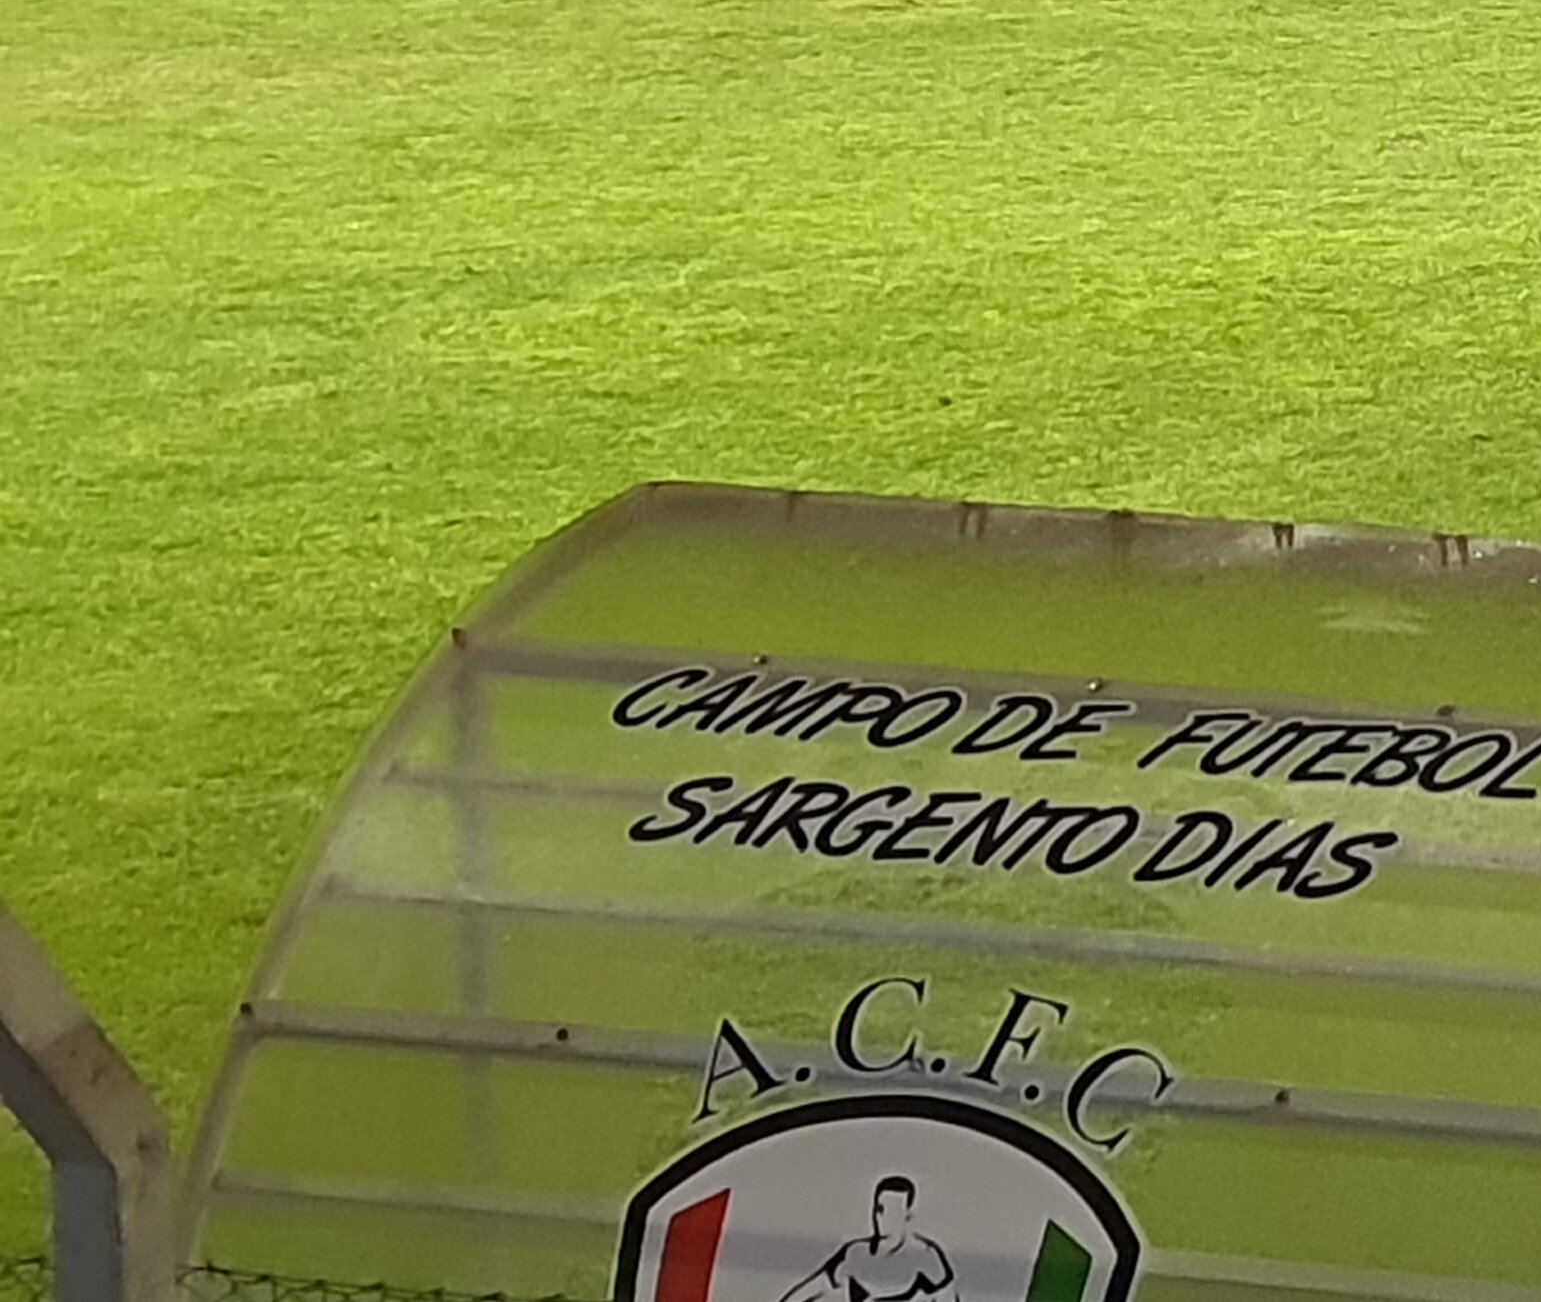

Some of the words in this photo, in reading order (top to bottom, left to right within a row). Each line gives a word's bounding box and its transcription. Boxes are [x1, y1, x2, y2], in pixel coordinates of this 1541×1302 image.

[610, 667, 964, 750] CAMPO
[950, 695, 1131, 762] DE
[627, 775, 1141, 876] SARGENTO
[1131, 810, 1400, 901] DIAS
